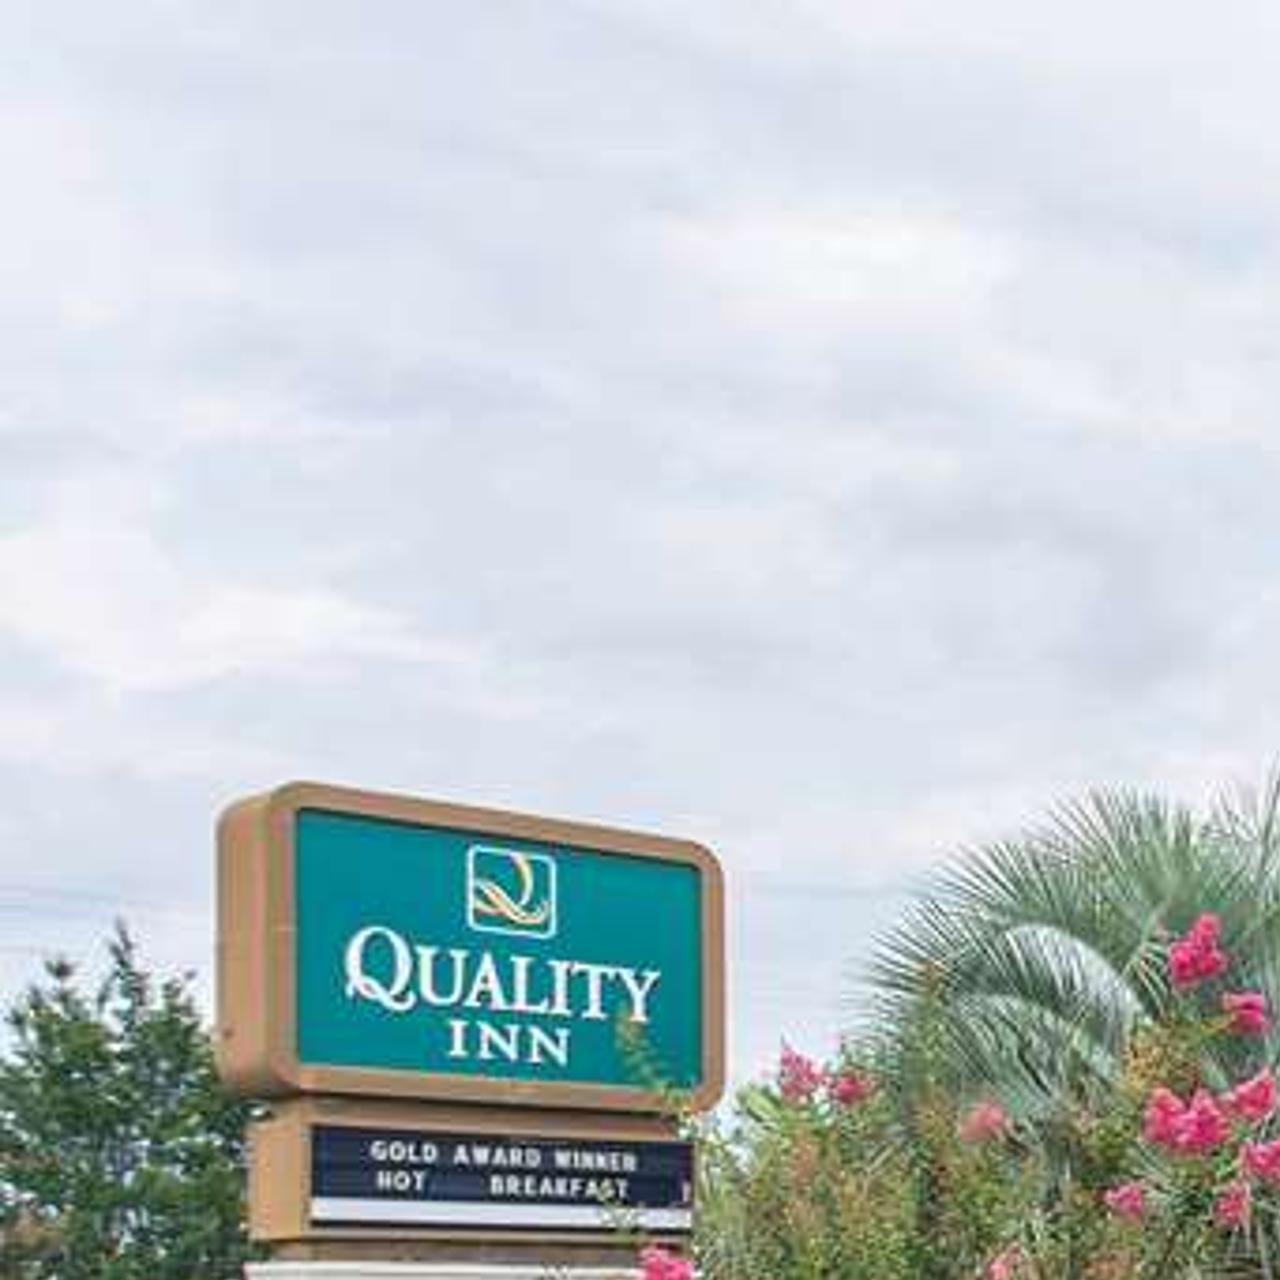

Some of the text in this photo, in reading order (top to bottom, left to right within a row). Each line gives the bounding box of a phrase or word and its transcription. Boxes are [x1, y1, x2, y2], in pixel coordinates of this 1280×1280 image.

[345, 926, 661, 1022] QUALITY
[447, 1018, 571, 1066] INN
[370, 1140, 637, 1173] GOLD AWARD WINNER
[377, 1171, 630, 1199] HOT BREAKFAST
